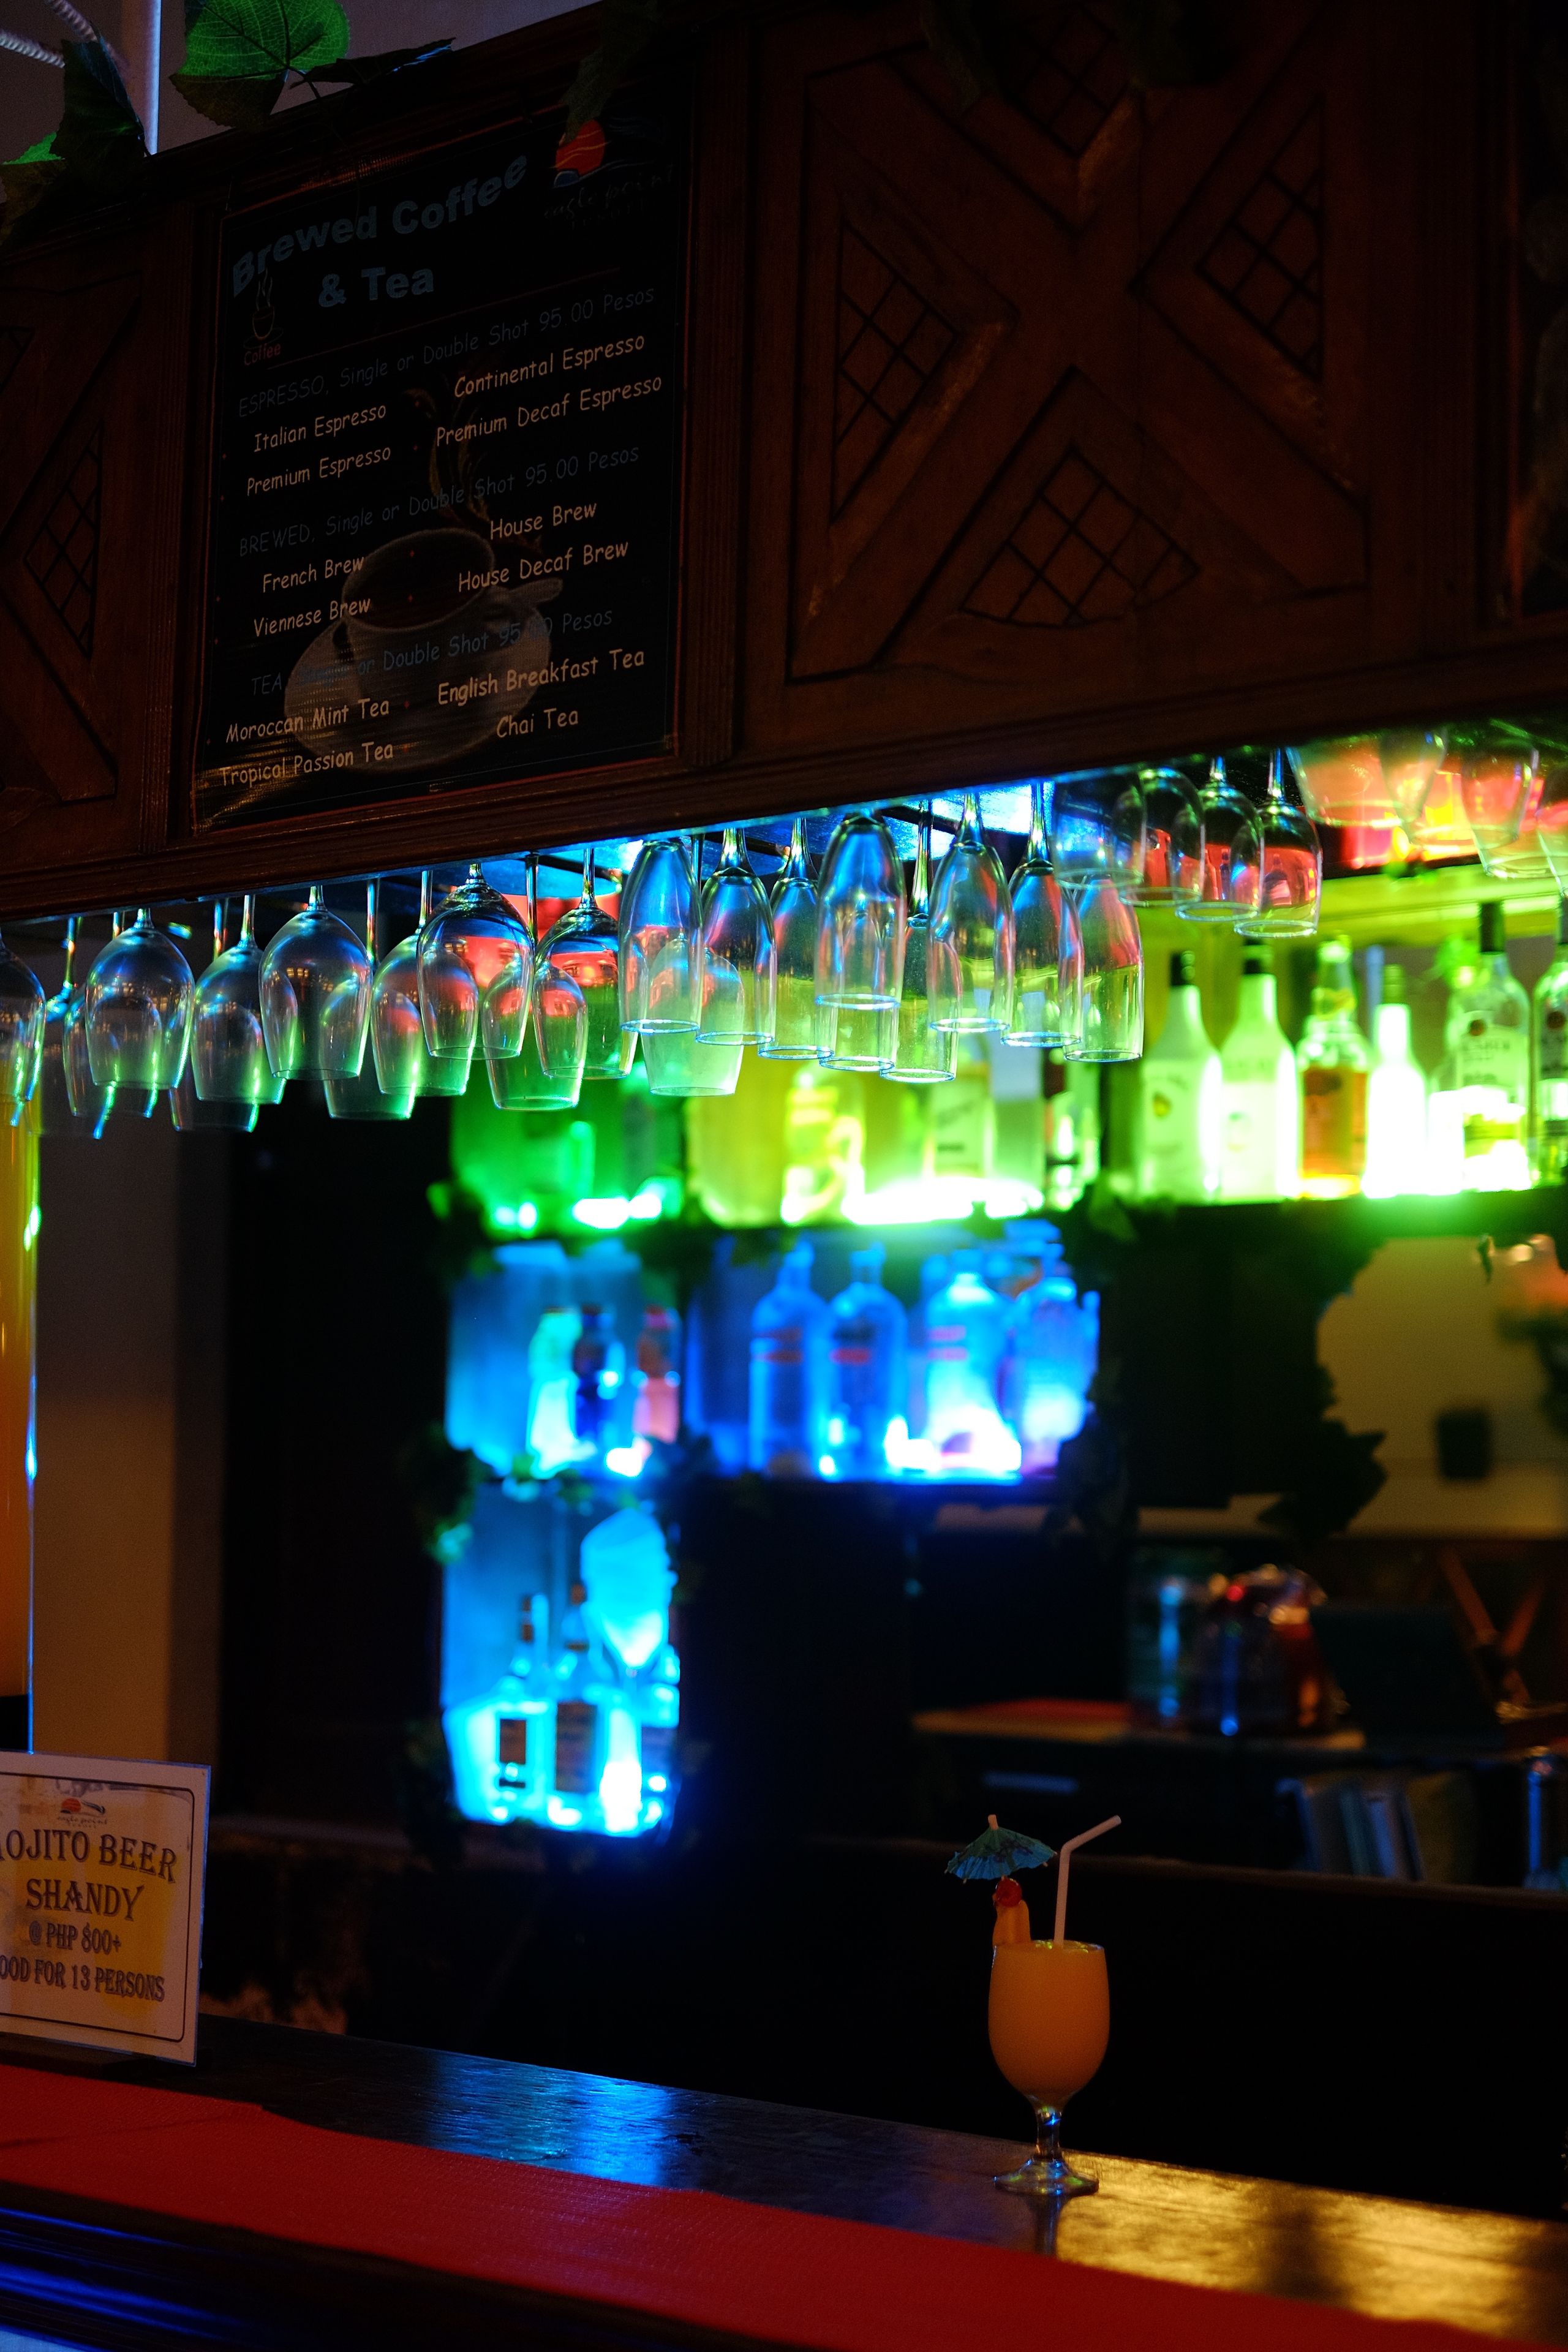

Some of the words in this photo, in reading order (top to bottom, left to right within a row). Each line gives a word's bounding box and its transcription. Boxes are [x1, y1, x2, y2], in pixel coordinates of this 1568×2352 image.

[232, 206, 378, 298] Brewed
[391, 154, 529, 235] Coffee
[318, 273, 347, 308] &
[360, 265, 435, 301] Tea
[243, 342, 282, 367] Coffee
[339, 358, 388, 387] Single
[397, 355, 414, 371] or
[423, 328, 480, 364] Double
[489, 318, 529, 345] Shot
[603, 288, 654, 314] Pesos
[454, 352, 554, 398] Continental
[562, 335, 645, 371] Espresso
[254, 426, 306, 453] Italian
[314, 405, 386, 437] Espresso
[436, 417, 508, 447] Premium
[517, 393, 571, 428] Decaf
[579, 376, 662, 412] Espresso
[247, 467, 311, 496] Premium
[318, 447, 391, 479] Espresso
[325, 507, 372, 535] Single
[382, 503, 400, 521] or
[409, 486, 465, 516] Double
[475, 475, 514, 500] Shot
[589, 447, 639, 473] Pesos
[491, 515, 543, 540] House
[552, 502, 598, 527] Brew
[262, 564, 317, 593] French
[325, 556, 364, 579] Brew
[458, 567, 510, 593] House
[519, 547, 573, 579] Decaf
[583, 541, 628, 566] Brew
[254, 609, 322, 637] Viennese
[330, 598, 371, 620] Brew
[383, 641, 440, 672] Double
[448, 631, 489, 657] Shot
[563, 610, 613, 635] Pesos
[437, 673, 499, 706] English
[507, 656, 599, 692] Breakfast
[609, 648, 645, 671] Tea
[226, 715, 304, 743] Moroccan
[312, 704, 350, 729] Mint
[358, 697, 390, 720] Tea
[496, 713, 534, 738] Chai
[543, 707, 579, 729] Tea
[221, 756, 285, 788] Tropical
[294, 750, 353, 774] Passion
[361, 741, 394, 763] Tea
[0, 1829, 89, 1862] OJITO
[99, 1834, 176, 1884] BEER
[26, 1878, 145, 1922] SHANDY
[29, 1920, 42, 1946] @
[46, 1922, 78, 1950] PHP
[34, 1959, 66, 1989] FOR
[72, 1964, 90, 1991] 13
[95, 1967, 165, 2002] PERSONS
